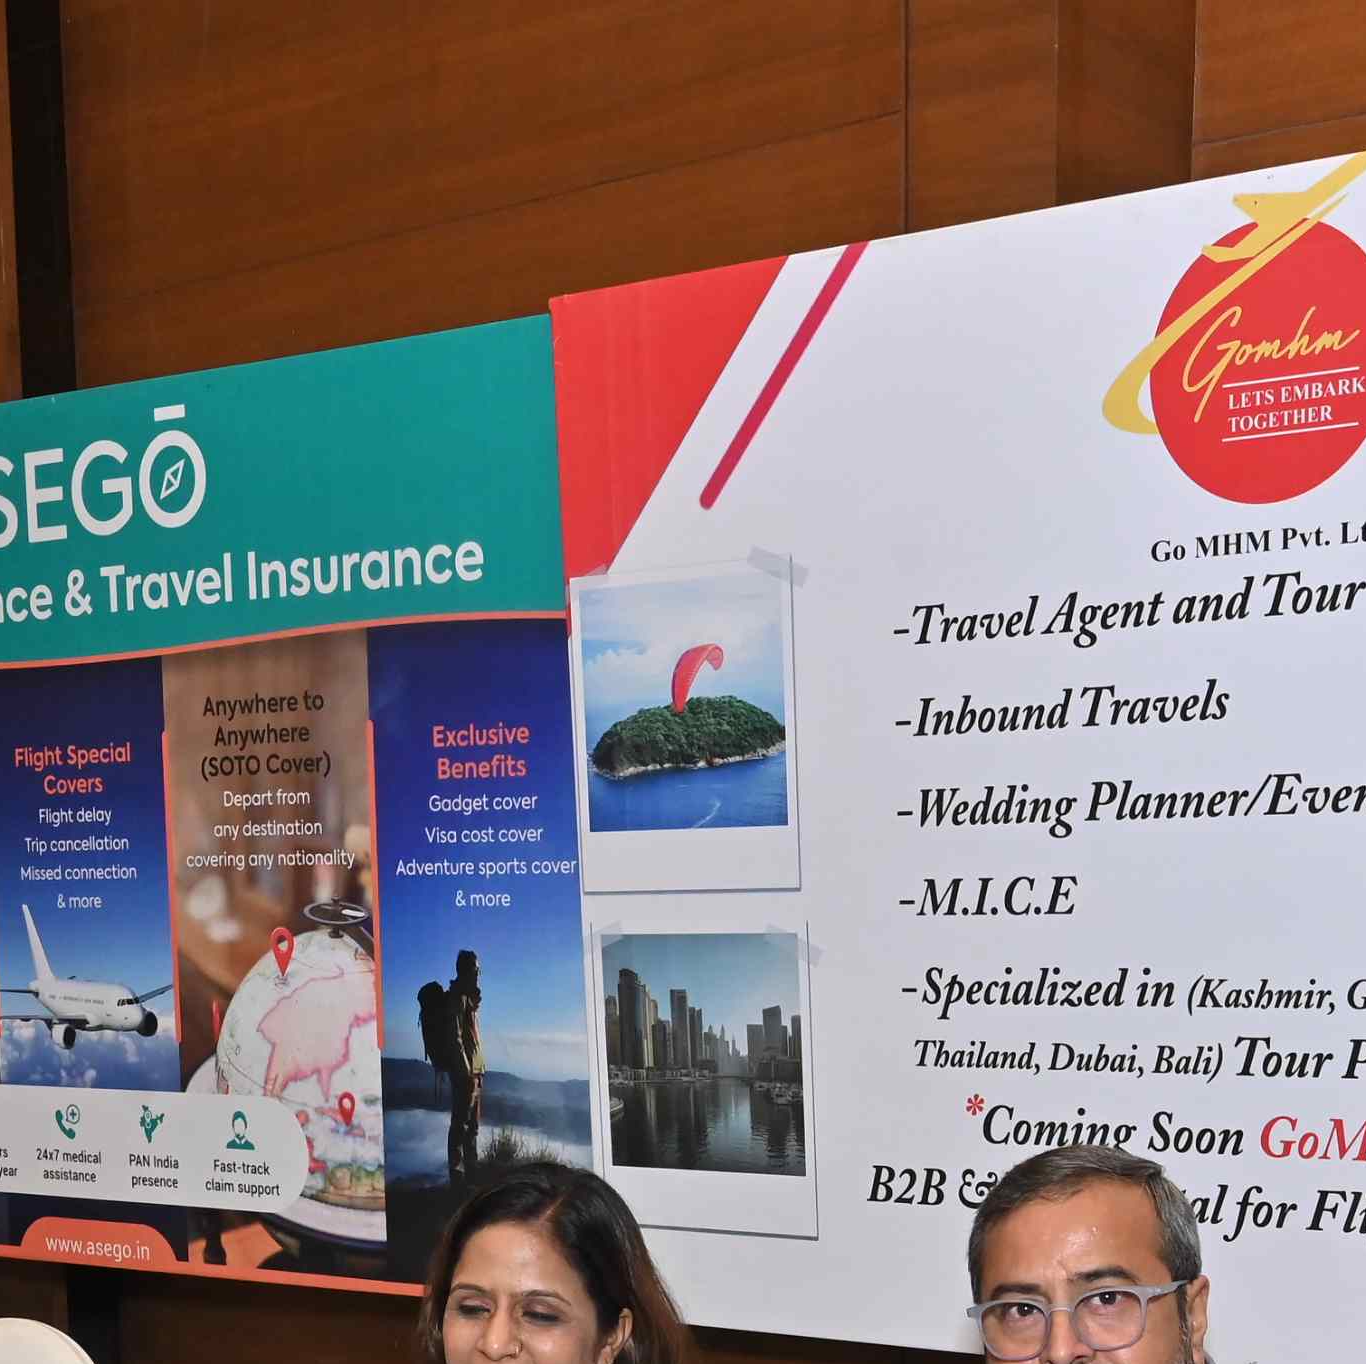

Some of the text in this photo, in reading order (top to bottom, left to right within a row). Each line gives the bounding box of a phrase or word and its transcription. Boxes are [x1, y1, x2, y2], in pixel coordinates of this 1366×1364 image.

[1228, 375, 1366, 410] LETS EMBARK
[1228, 405, 1333, 432] TOGETHER
[1151, 540, 1186, 563] Go
[1195, 530, 1271, 558] MHM
[1281, 527, 1330, 550] Pvt.
[66, 579, 92, 617] &
[101, 552, 233, 613] Travel
[248, 539, 484, 601] Insurance
[1042, 590, 1164, 649] Agent
[1173, 576, 1250, 624] and
[1264, 571, 1366, 618] Tour
[203, 691, 324, 722] Anywhere to
[1081, 678, 1230, 729] Travels
[214, 727, 310, 752] Anywhere
[433, 722, 529, 748] Exclusive
[15, 742, 130, 770] Flight Special
[201, 752, 331, 782] (SOTO Cover)
[437, 757, 527, 780] Benefits
[44, 775, 103, 794] Covers
[223, 789, 310, 810] Depart from
[429, 795, 538, 814] Gadget cover
[39, 808, 111, 826] Flight delay
[213, 820, 322, 839] any destination
[425, 827, 544, 843] Visa cost cover
[25, 837, 129, 855] Trip cancellation
[186, 850, 354, 870] covering any nationality
[396, 860, 577, 877] Adventure sports cover
[21, 863, 137, 881] Missed connection
[57, 895, 102, 908] & more
[455, 892, 511, 906] & more
[1136, 971, 1176, 1009] in
[1187, 976, 1336, 1016] (Kashmir,
[915, 1038, 1041, 1075] Thailand,
[1048, 1041, 1144, 1078] Dubai,
[1152, 1044, 1225, 1080] Bali)
[1235, 1036, 1334, 1081] Tour
[1147, 1111, 1245, 1158] Soon
[36, 1149, 101, 1165] 24x7 medical
[129, 1155, 179, 1170] PAN India
[213, 1160, 270, 1176] Fast-track
[43, 1168, 97, 1184] assistance
[131, 1175, 178, 1190] presence
[869, 1165, 946, 1207] B2B
[205, 1179, 280, 1197] claim support
[1223, 1186, 1298, 1243] for
[45, 1236, 150, 1262] www.asego.in
